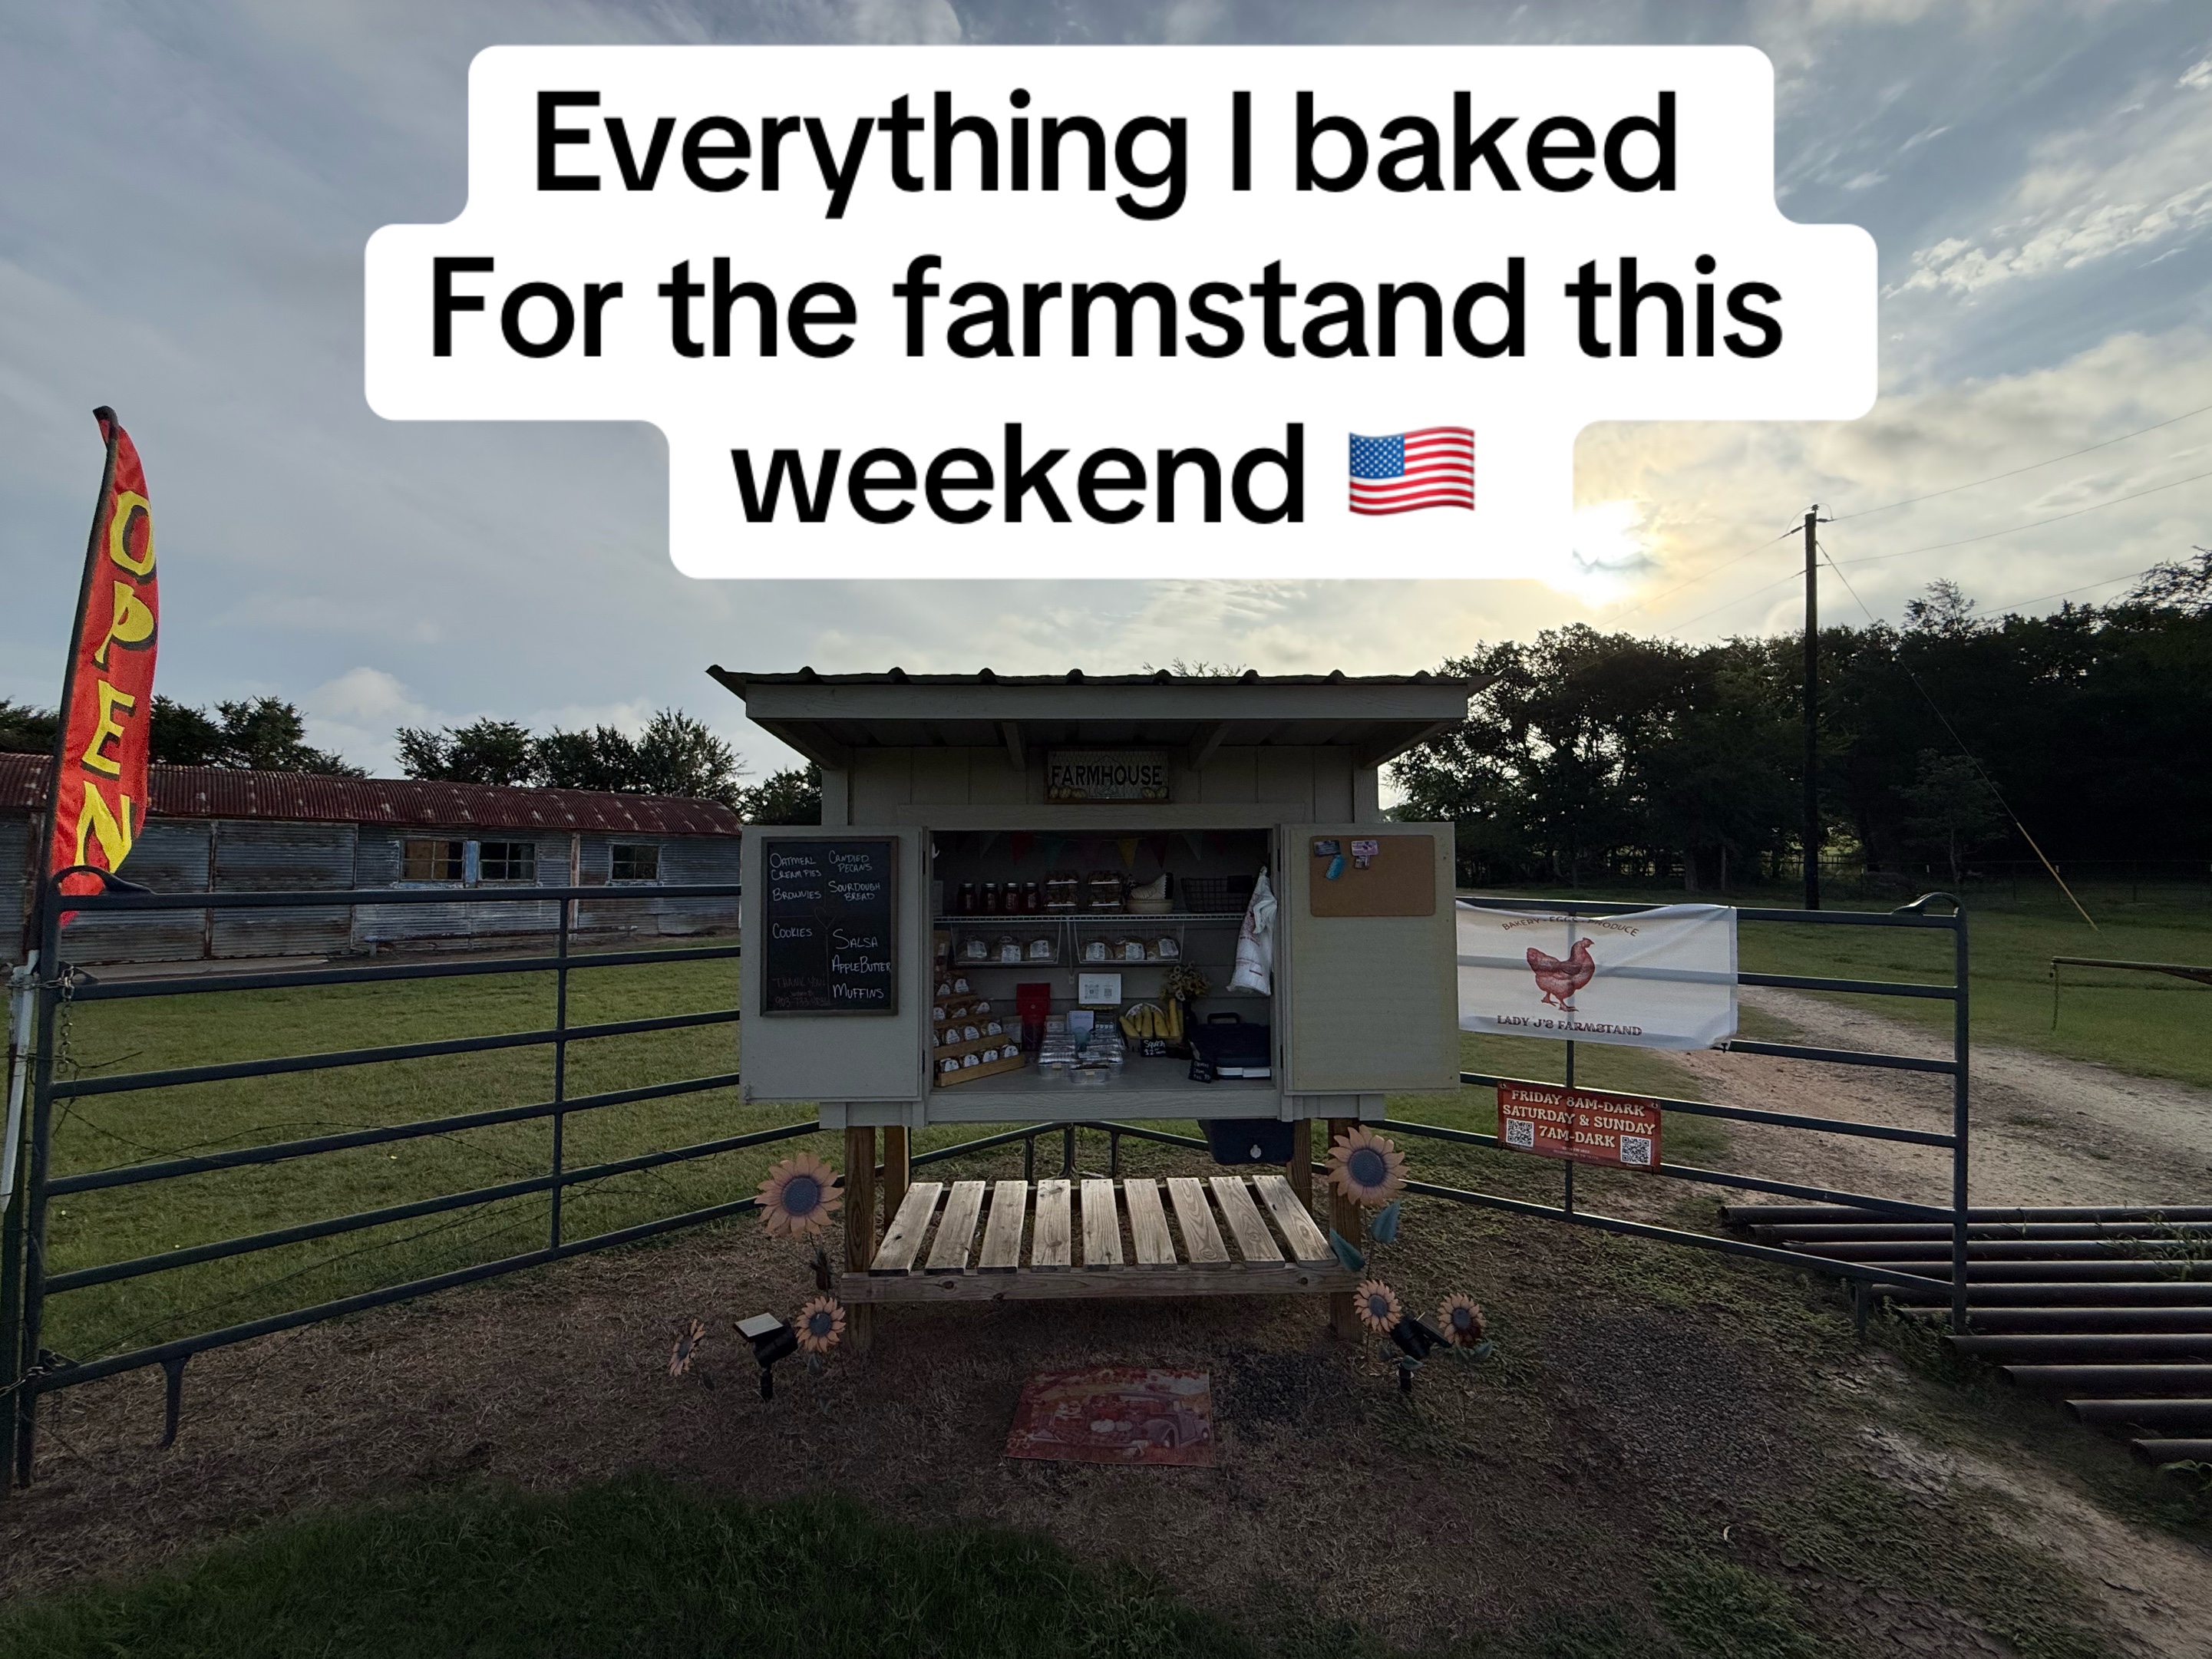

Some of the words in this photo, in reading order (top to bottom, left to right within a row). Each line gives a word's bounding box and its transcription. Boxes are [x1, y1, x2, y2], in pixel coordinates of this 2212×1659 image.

[74, 489, 156, 875] OPEN
[1052, 765, 1163, 786] FARMHOUSE
[770, 853, 817, 868] OATMEAL
[828, 849, 870, 864] CANDIED
[771, 869, 802, 881] CREAM
[837, 862, 873, 873] PECANS
[772, 887, 822, 902] BROWNIES
[828, 880, 880, 892] SOURDOUGH
[844, 892, 875, 902] BREAD
[772, 922, 813, 939] COOKIES
[1501, 918, 1540, 931] BAKERY
[1587, 919, 1640, 937] PRODUCE
[833, 928, 879, 949] SALSA
[772, 977, 806, 988] THANK
[833, 982, 884, 999] MUFFINS
[1497, 1014, 1530, 1027] LADY
[1533, 1018, 1554, 1029] J'S
[1557, 1020, 1642, 1037] FARMSTAND
[1511, 1090, 1563, 1105] FRIDAY
[1566, 1096, 1646, 1117] 8AM-DARK
[1503, 1104, 1576, 1124] SATURDAY
[1580, 1114, 1590, 1126] &
[1593, 1116, 1656, 1135] SUNDAY
[1538, 1125, 1616, 1148] 7AM-DARK
